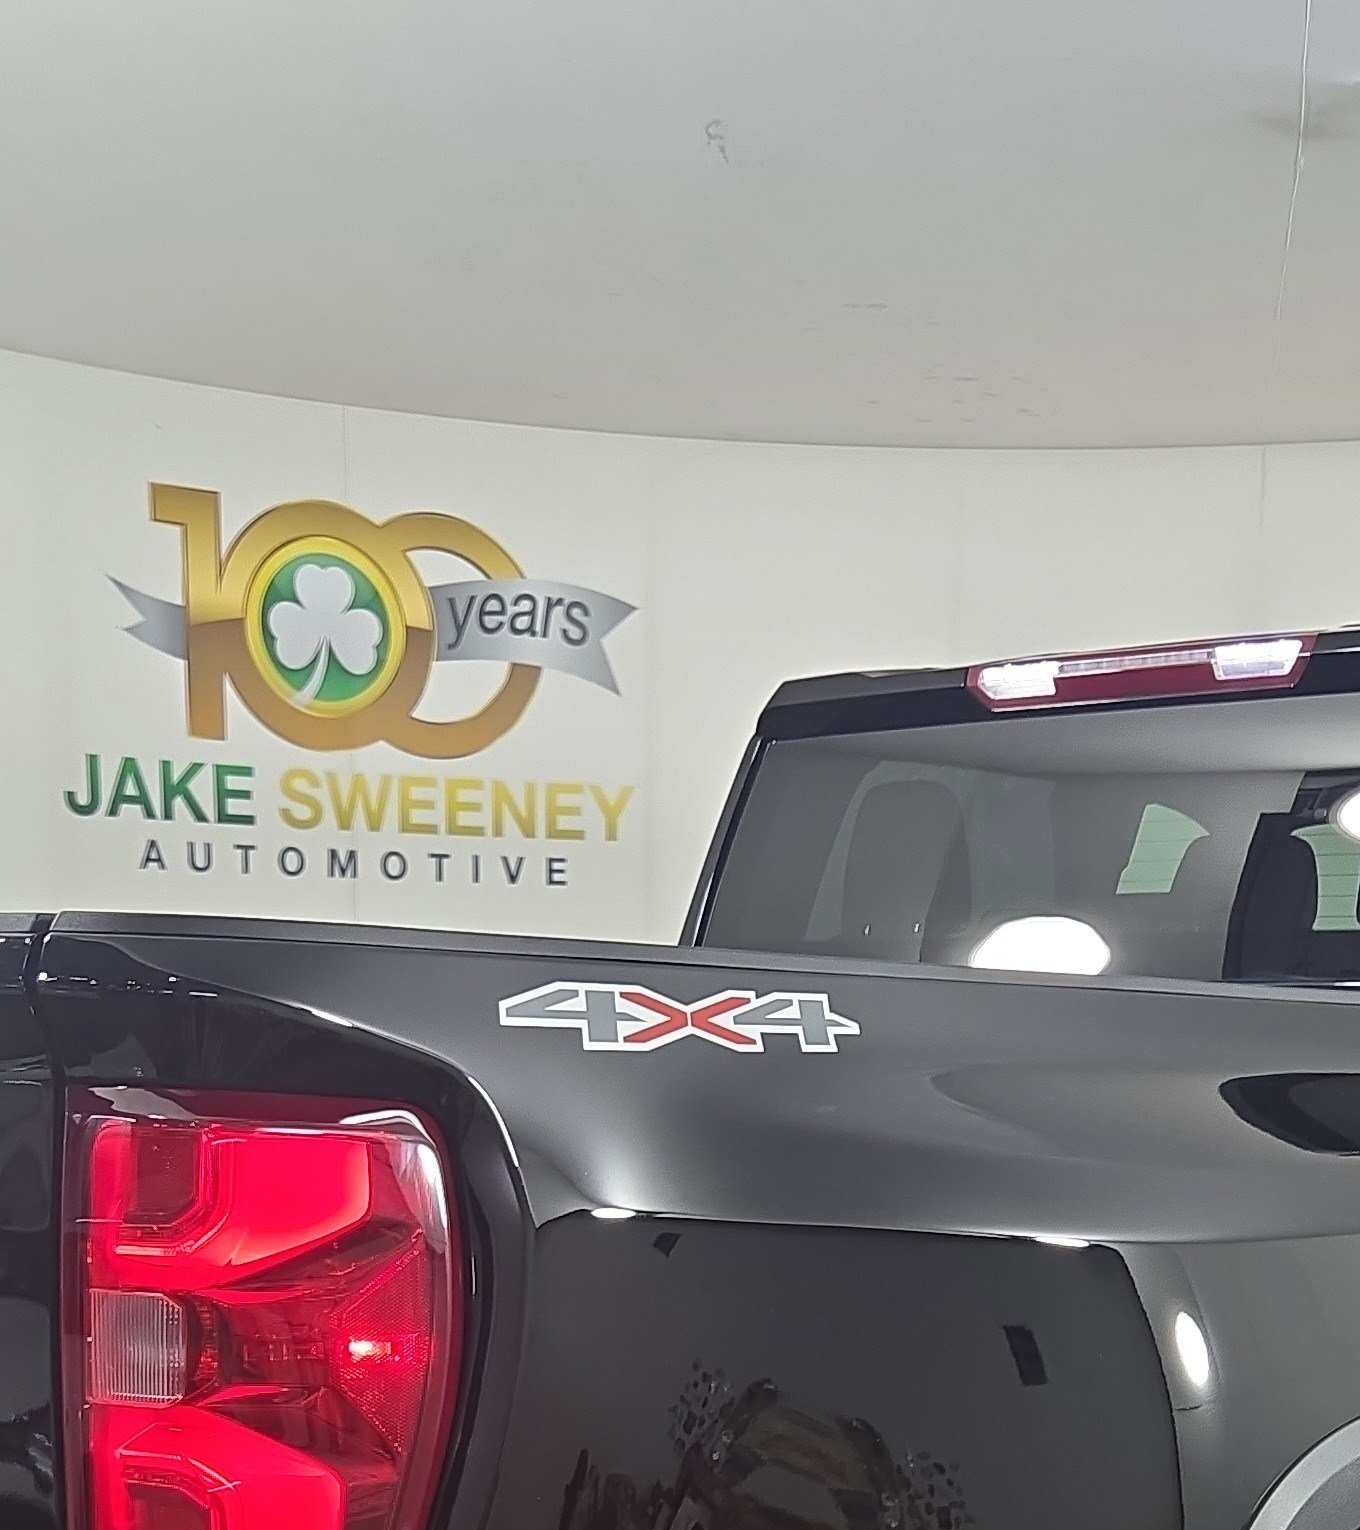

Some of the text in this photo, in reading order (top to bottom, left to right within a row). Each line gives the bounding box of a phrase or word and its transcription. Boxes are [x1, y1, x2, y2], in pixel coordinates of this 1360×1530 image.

[148, 481, 542, 760] 100
[445, 590, 592, 649] years
[62, 752, 635, 842] JAKE SWEENEY
[140, 839, 570, 887] AUTOMOTIVE
